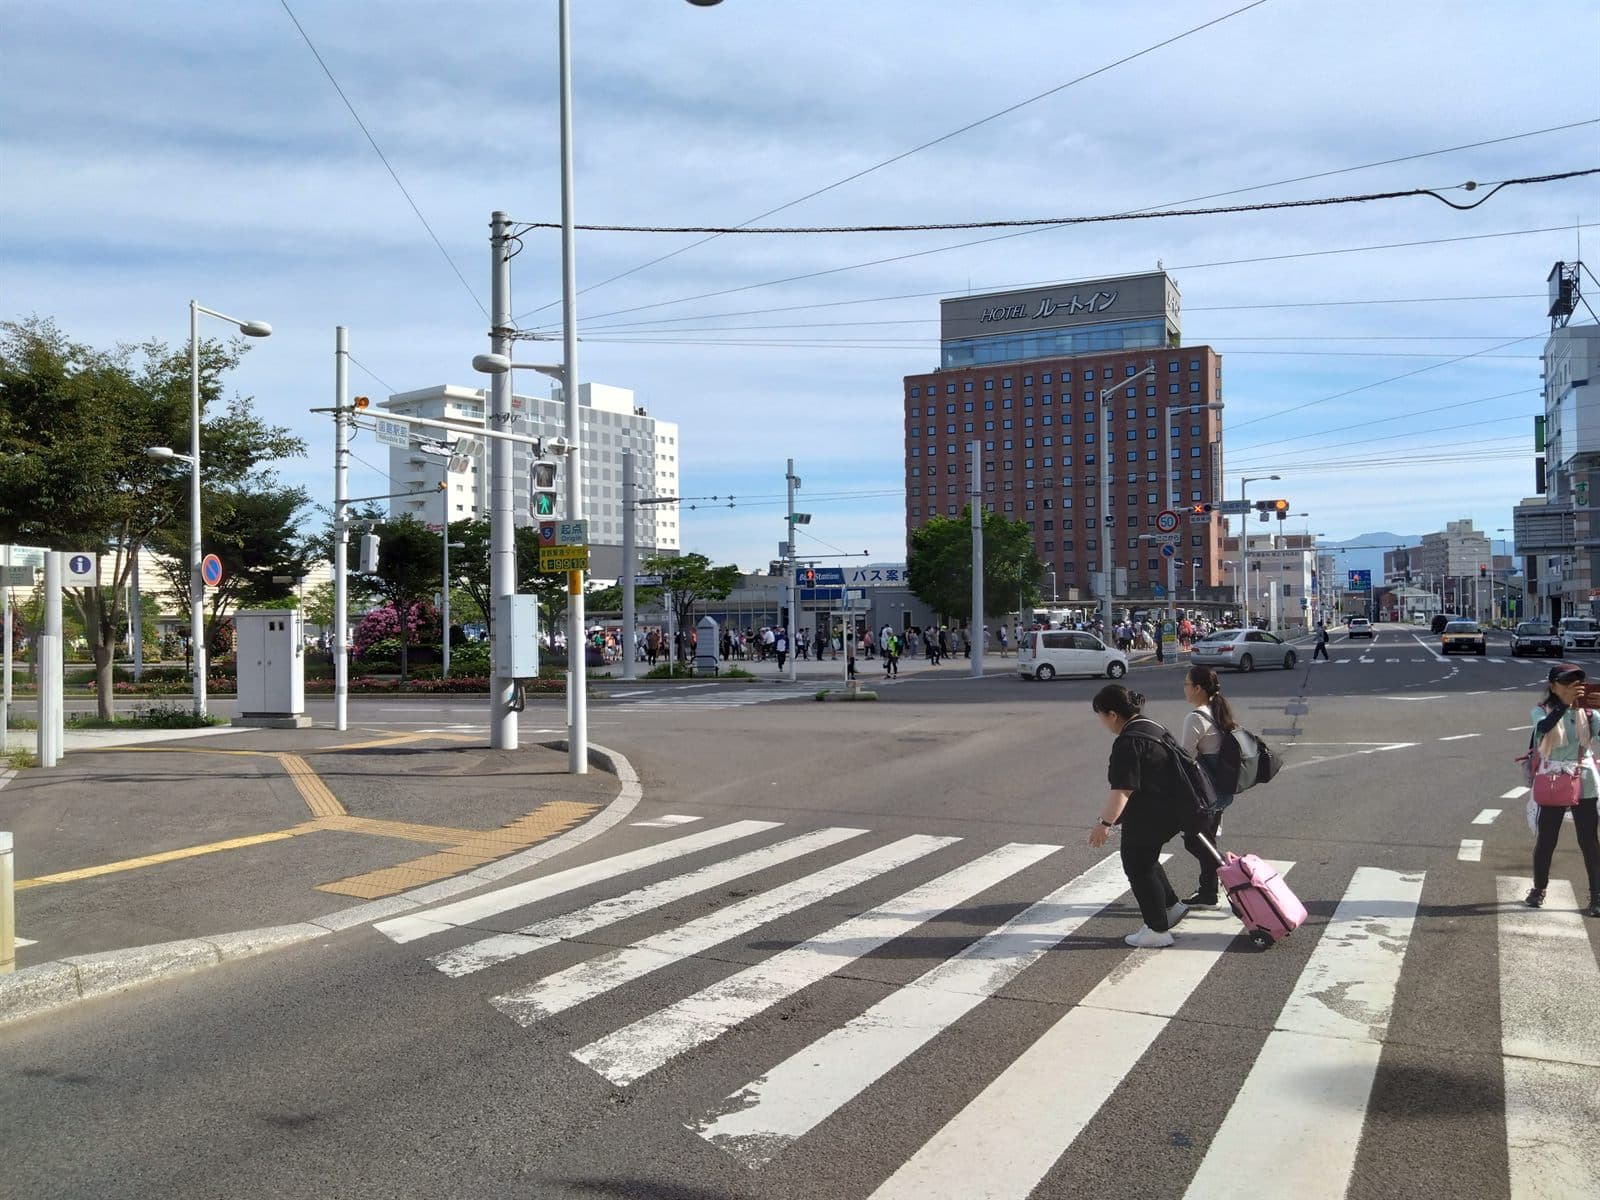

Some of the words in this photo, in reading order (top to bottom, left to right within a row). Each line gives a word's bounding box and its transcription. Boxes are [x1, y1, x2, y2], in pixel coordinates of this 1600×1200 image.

[980, 304, 1027, 322] HOTEL
[1032, 291, 1119, 319] ルートイン
[1576, 482, 1588, 506] すし
[1160, 516, 1175, 527] 50
[545, 528, 551, 537] 5
